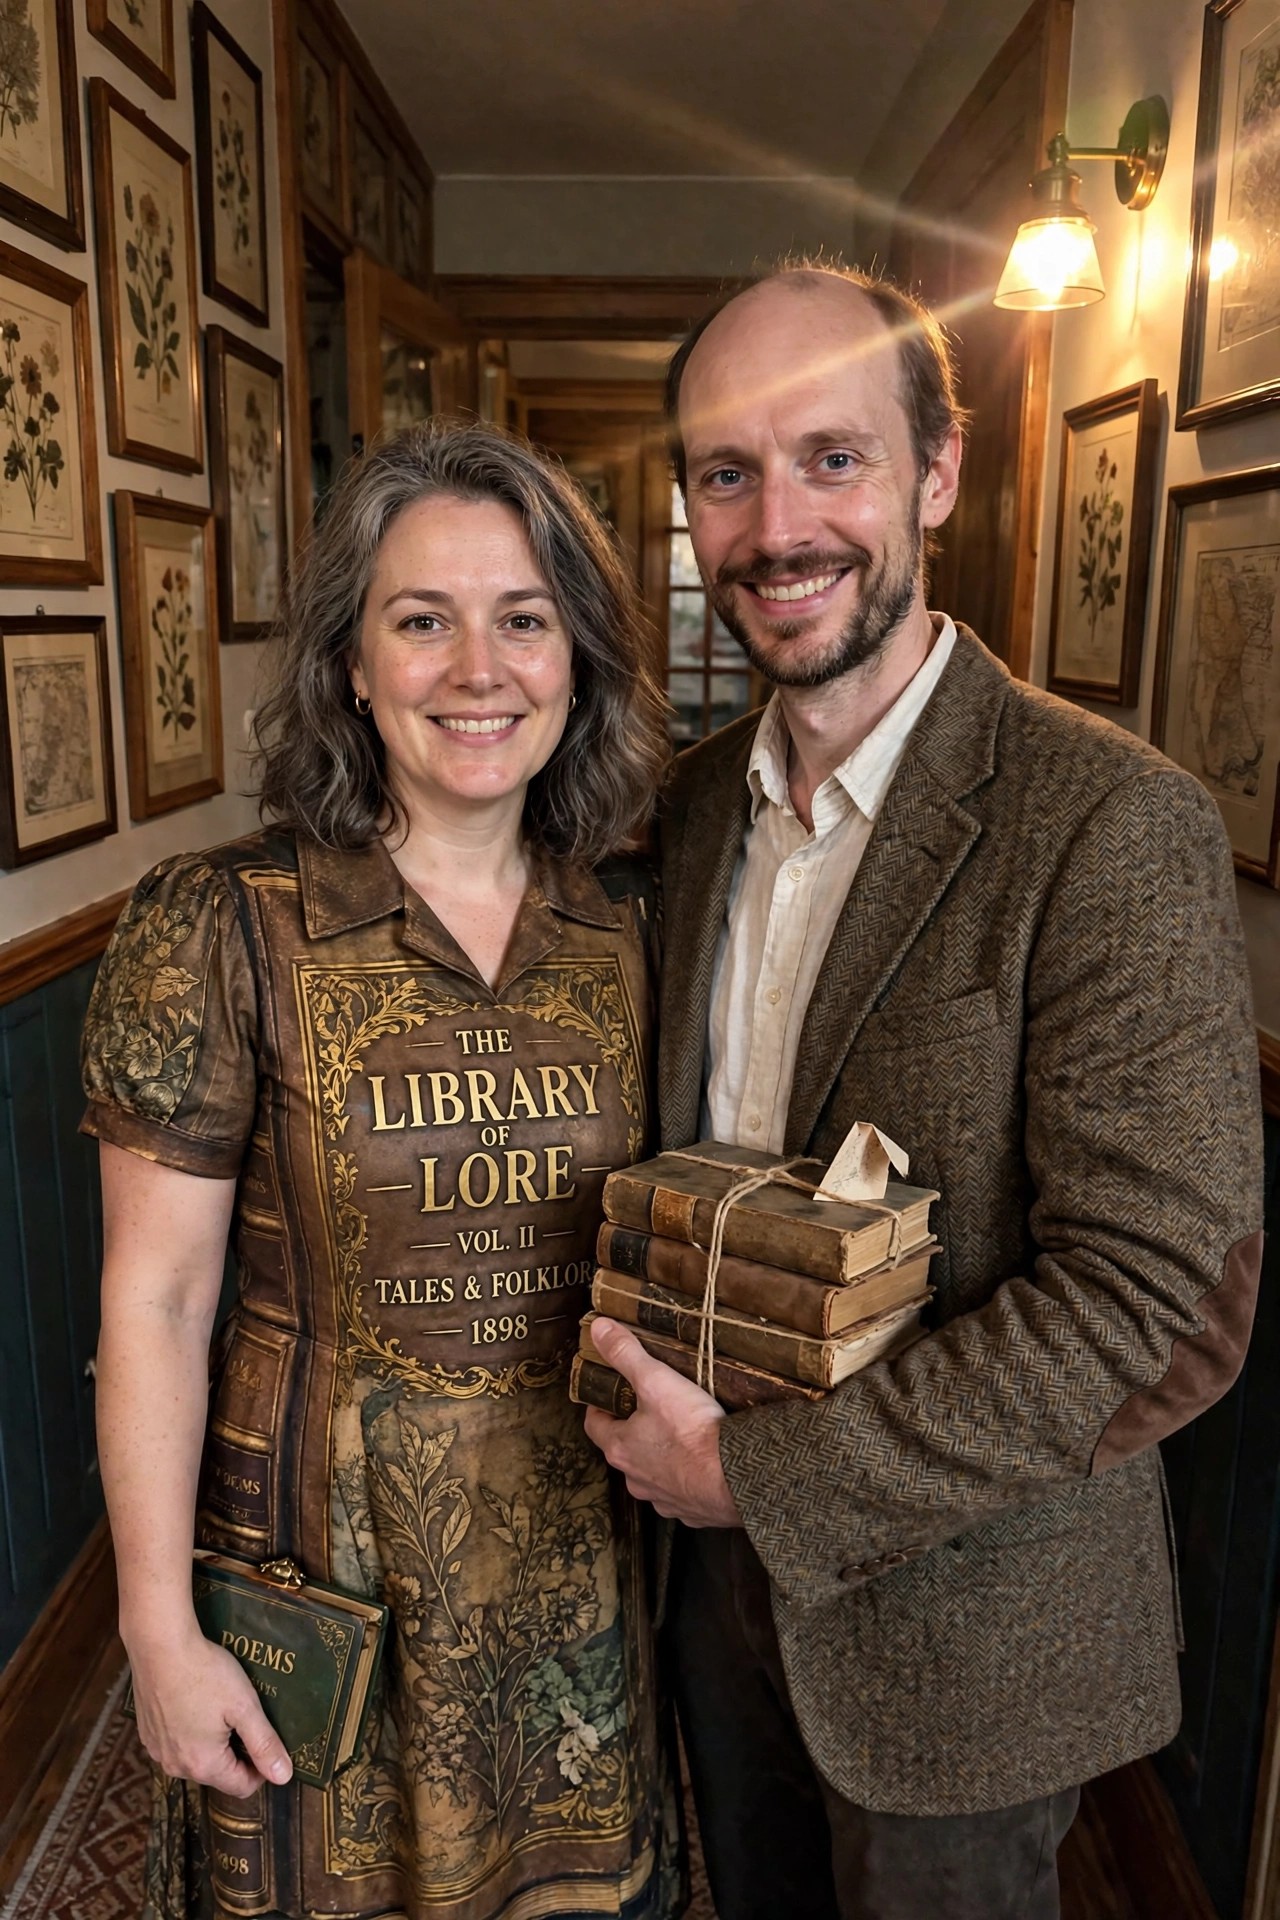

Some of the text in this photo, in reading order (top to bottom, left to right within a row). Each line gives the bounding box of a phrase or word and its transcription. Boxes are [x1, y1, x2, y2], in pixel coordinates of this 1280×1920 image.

[455, 1029, 513, 1055] THE
[368, 1064, 600, 1131] LIBRARY
[481, 1126, 511, 1147] OF
[420, 1145, 577, 1213] LORE
[456, 1225, 536, 1255] VOL. II
[374, 1260, 597, 1304] TALES & FOLKLOR
[471, 1314, 529, 1345] 1898
[221, 1630, 296, 1675] POEMS
